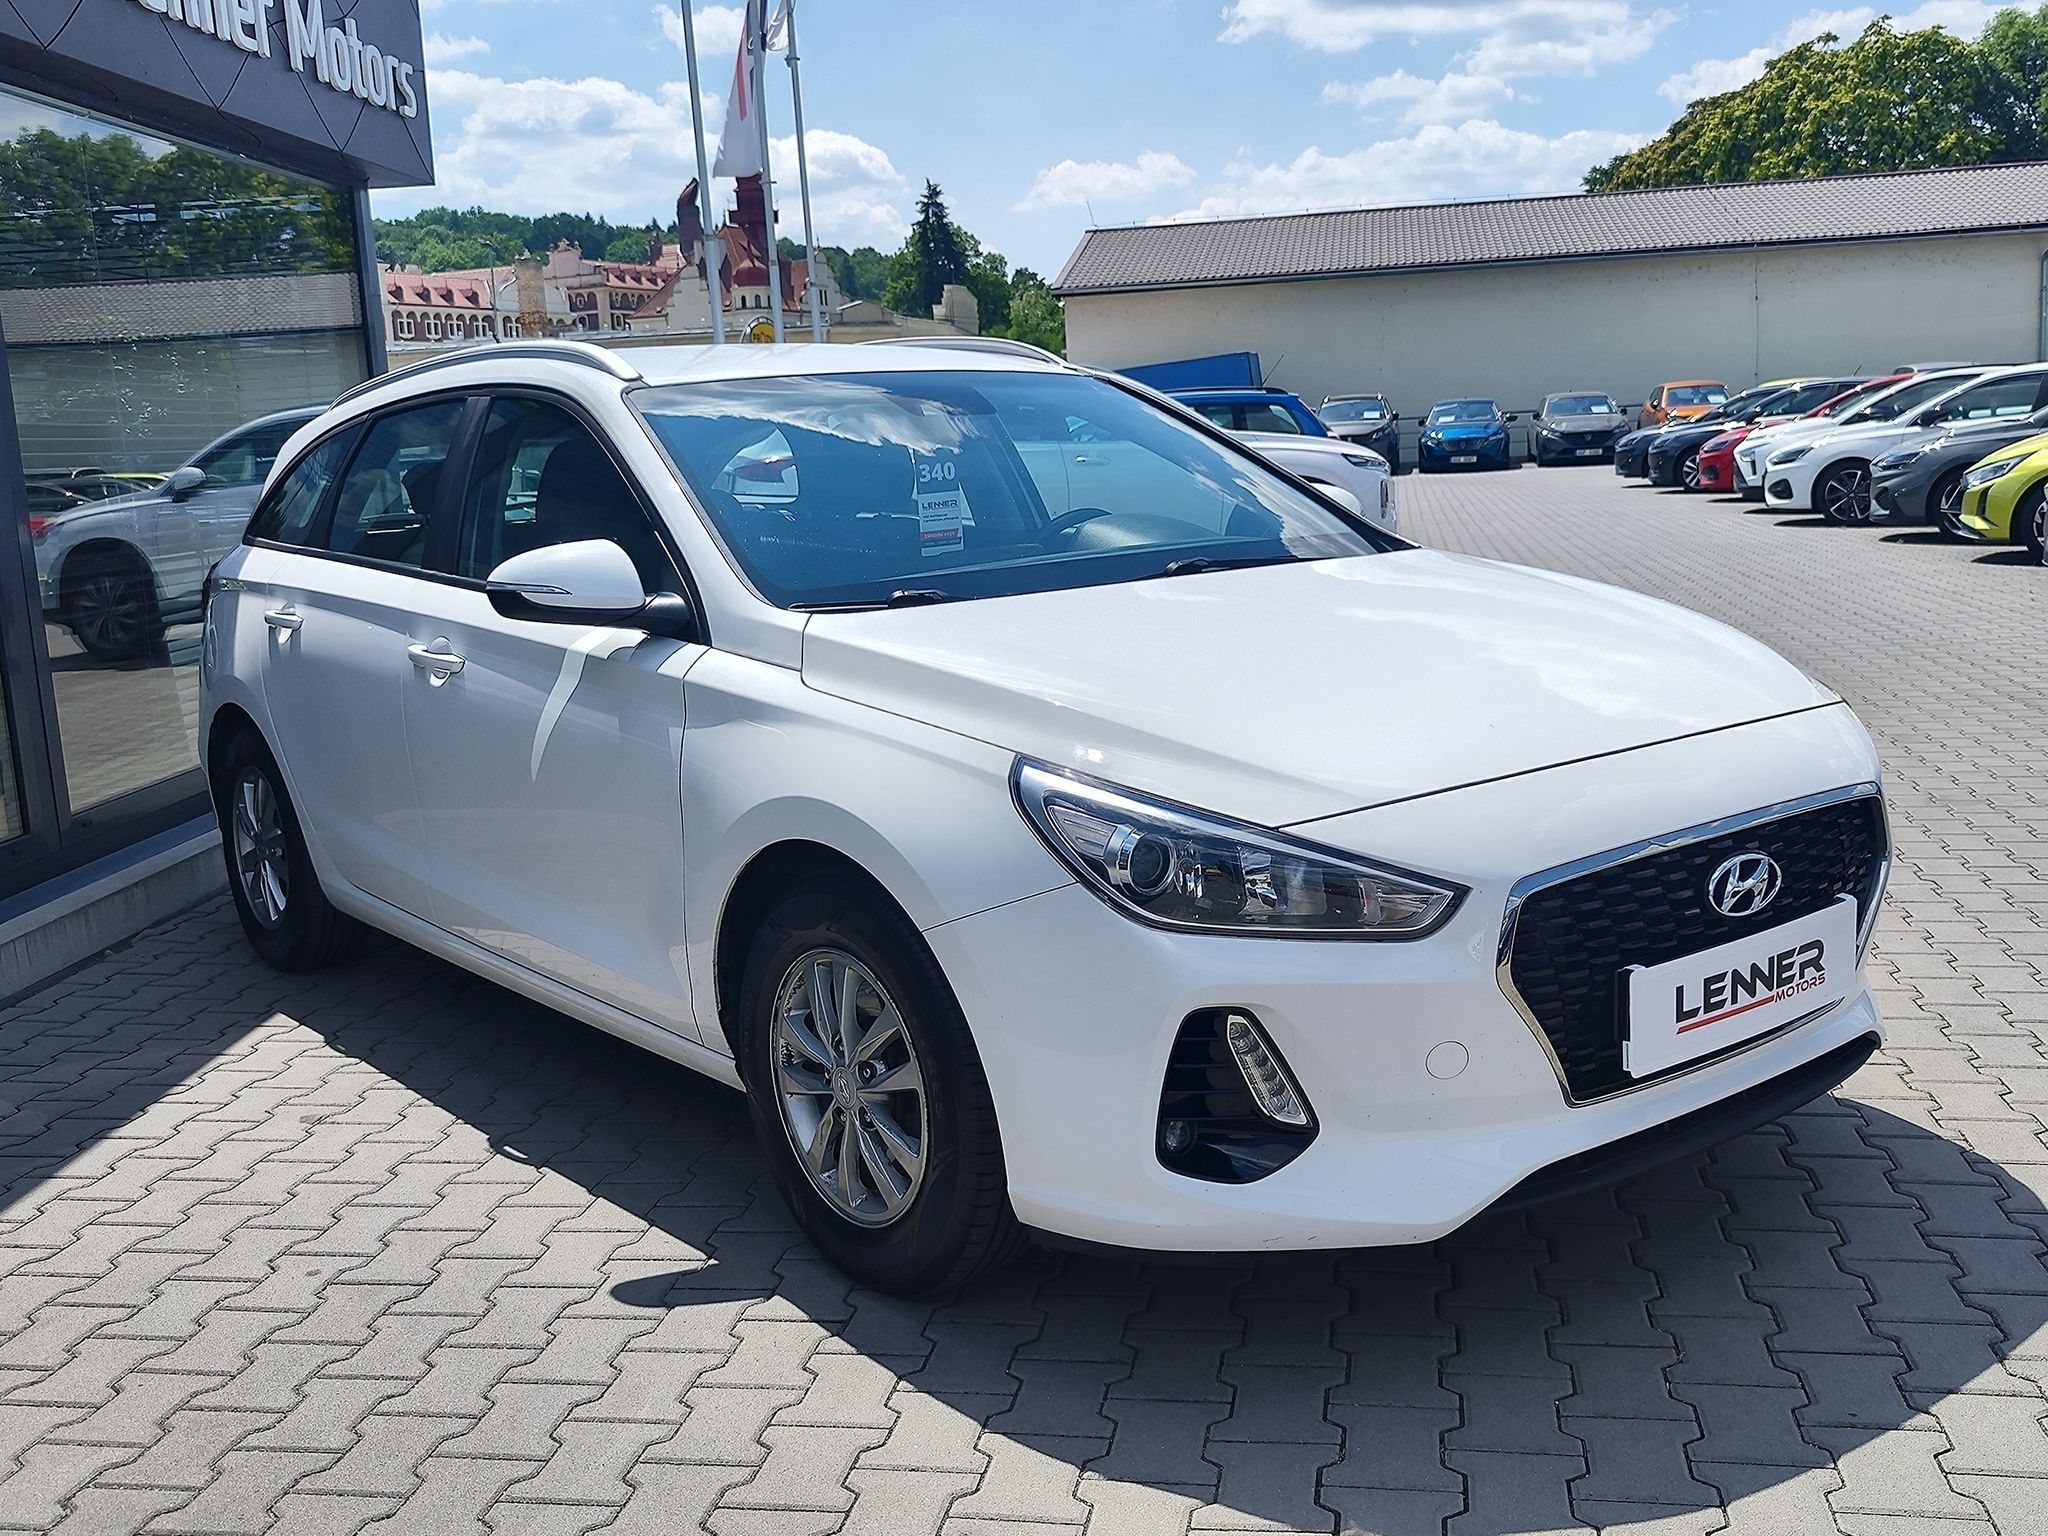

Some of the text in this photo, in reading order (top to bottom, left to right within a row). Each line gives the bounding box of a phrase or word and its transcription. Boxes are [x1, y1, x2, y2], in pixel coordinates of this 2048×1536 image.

[283, 0, 418, 119] Motors
[919, 461, 956, 483] 340
[921, 499, 959, 510] LENNER
[1676, 939, 1825, 1023] LENNER
[1774, 973, 1826, 1003] MOTORS
